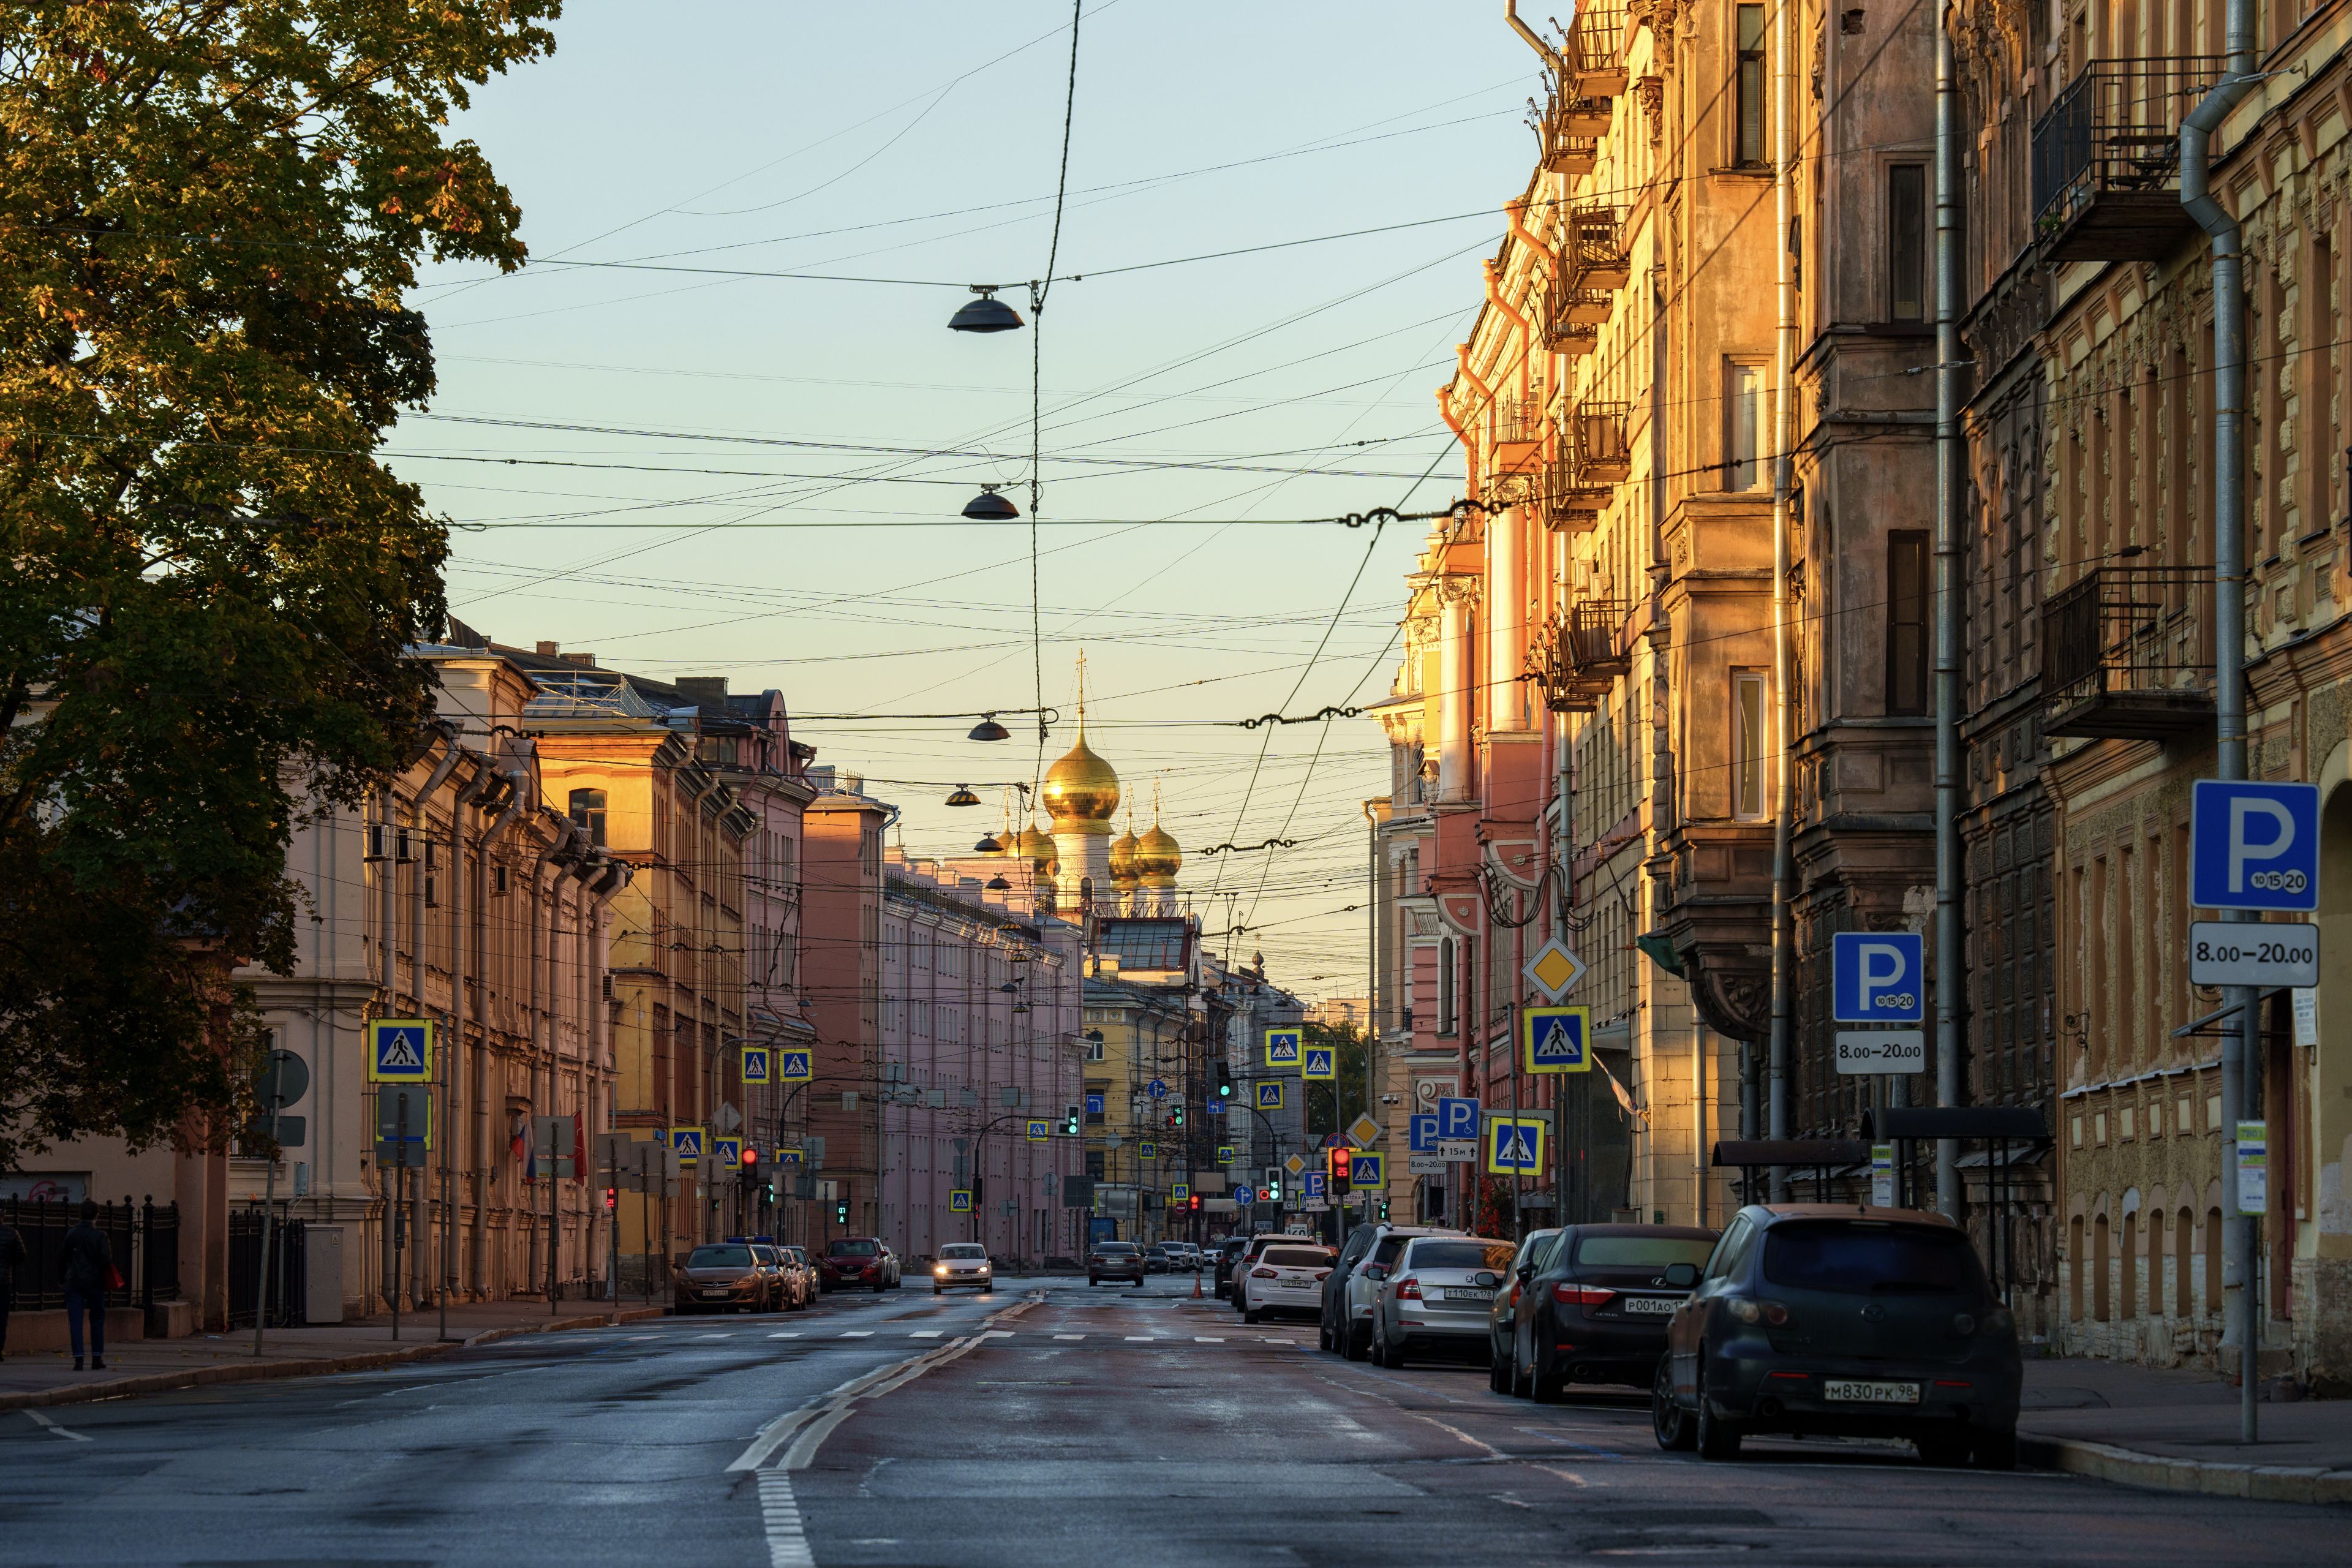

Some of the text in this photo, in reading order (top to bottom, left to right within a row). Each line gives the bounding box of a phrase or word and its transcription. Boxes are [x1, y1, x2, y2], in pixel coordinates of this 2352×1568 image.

[2228, 797, 2295, 892] P
[2255, 874, 2305, 888] 10 15 20
[2196, 941, 2313, 963] 8.00-20.00
[1860, 944, 1905, 1010] P
[1888, 997, 1896, 1005] 15
[1899, 996, 1913, 1006] 20
[1839, 1044, 1920, 1058] 8.00-20.00
[1449, 1102, 1471, 1133] P
[1420, 1118, 1438, 1147] P
[1448, 1289, 1478, 1298] Т110ЕК
[1628, 1300, 1671, 1311] Р001АО
[1830, 1384, 1913, 1400] М830РК 98
